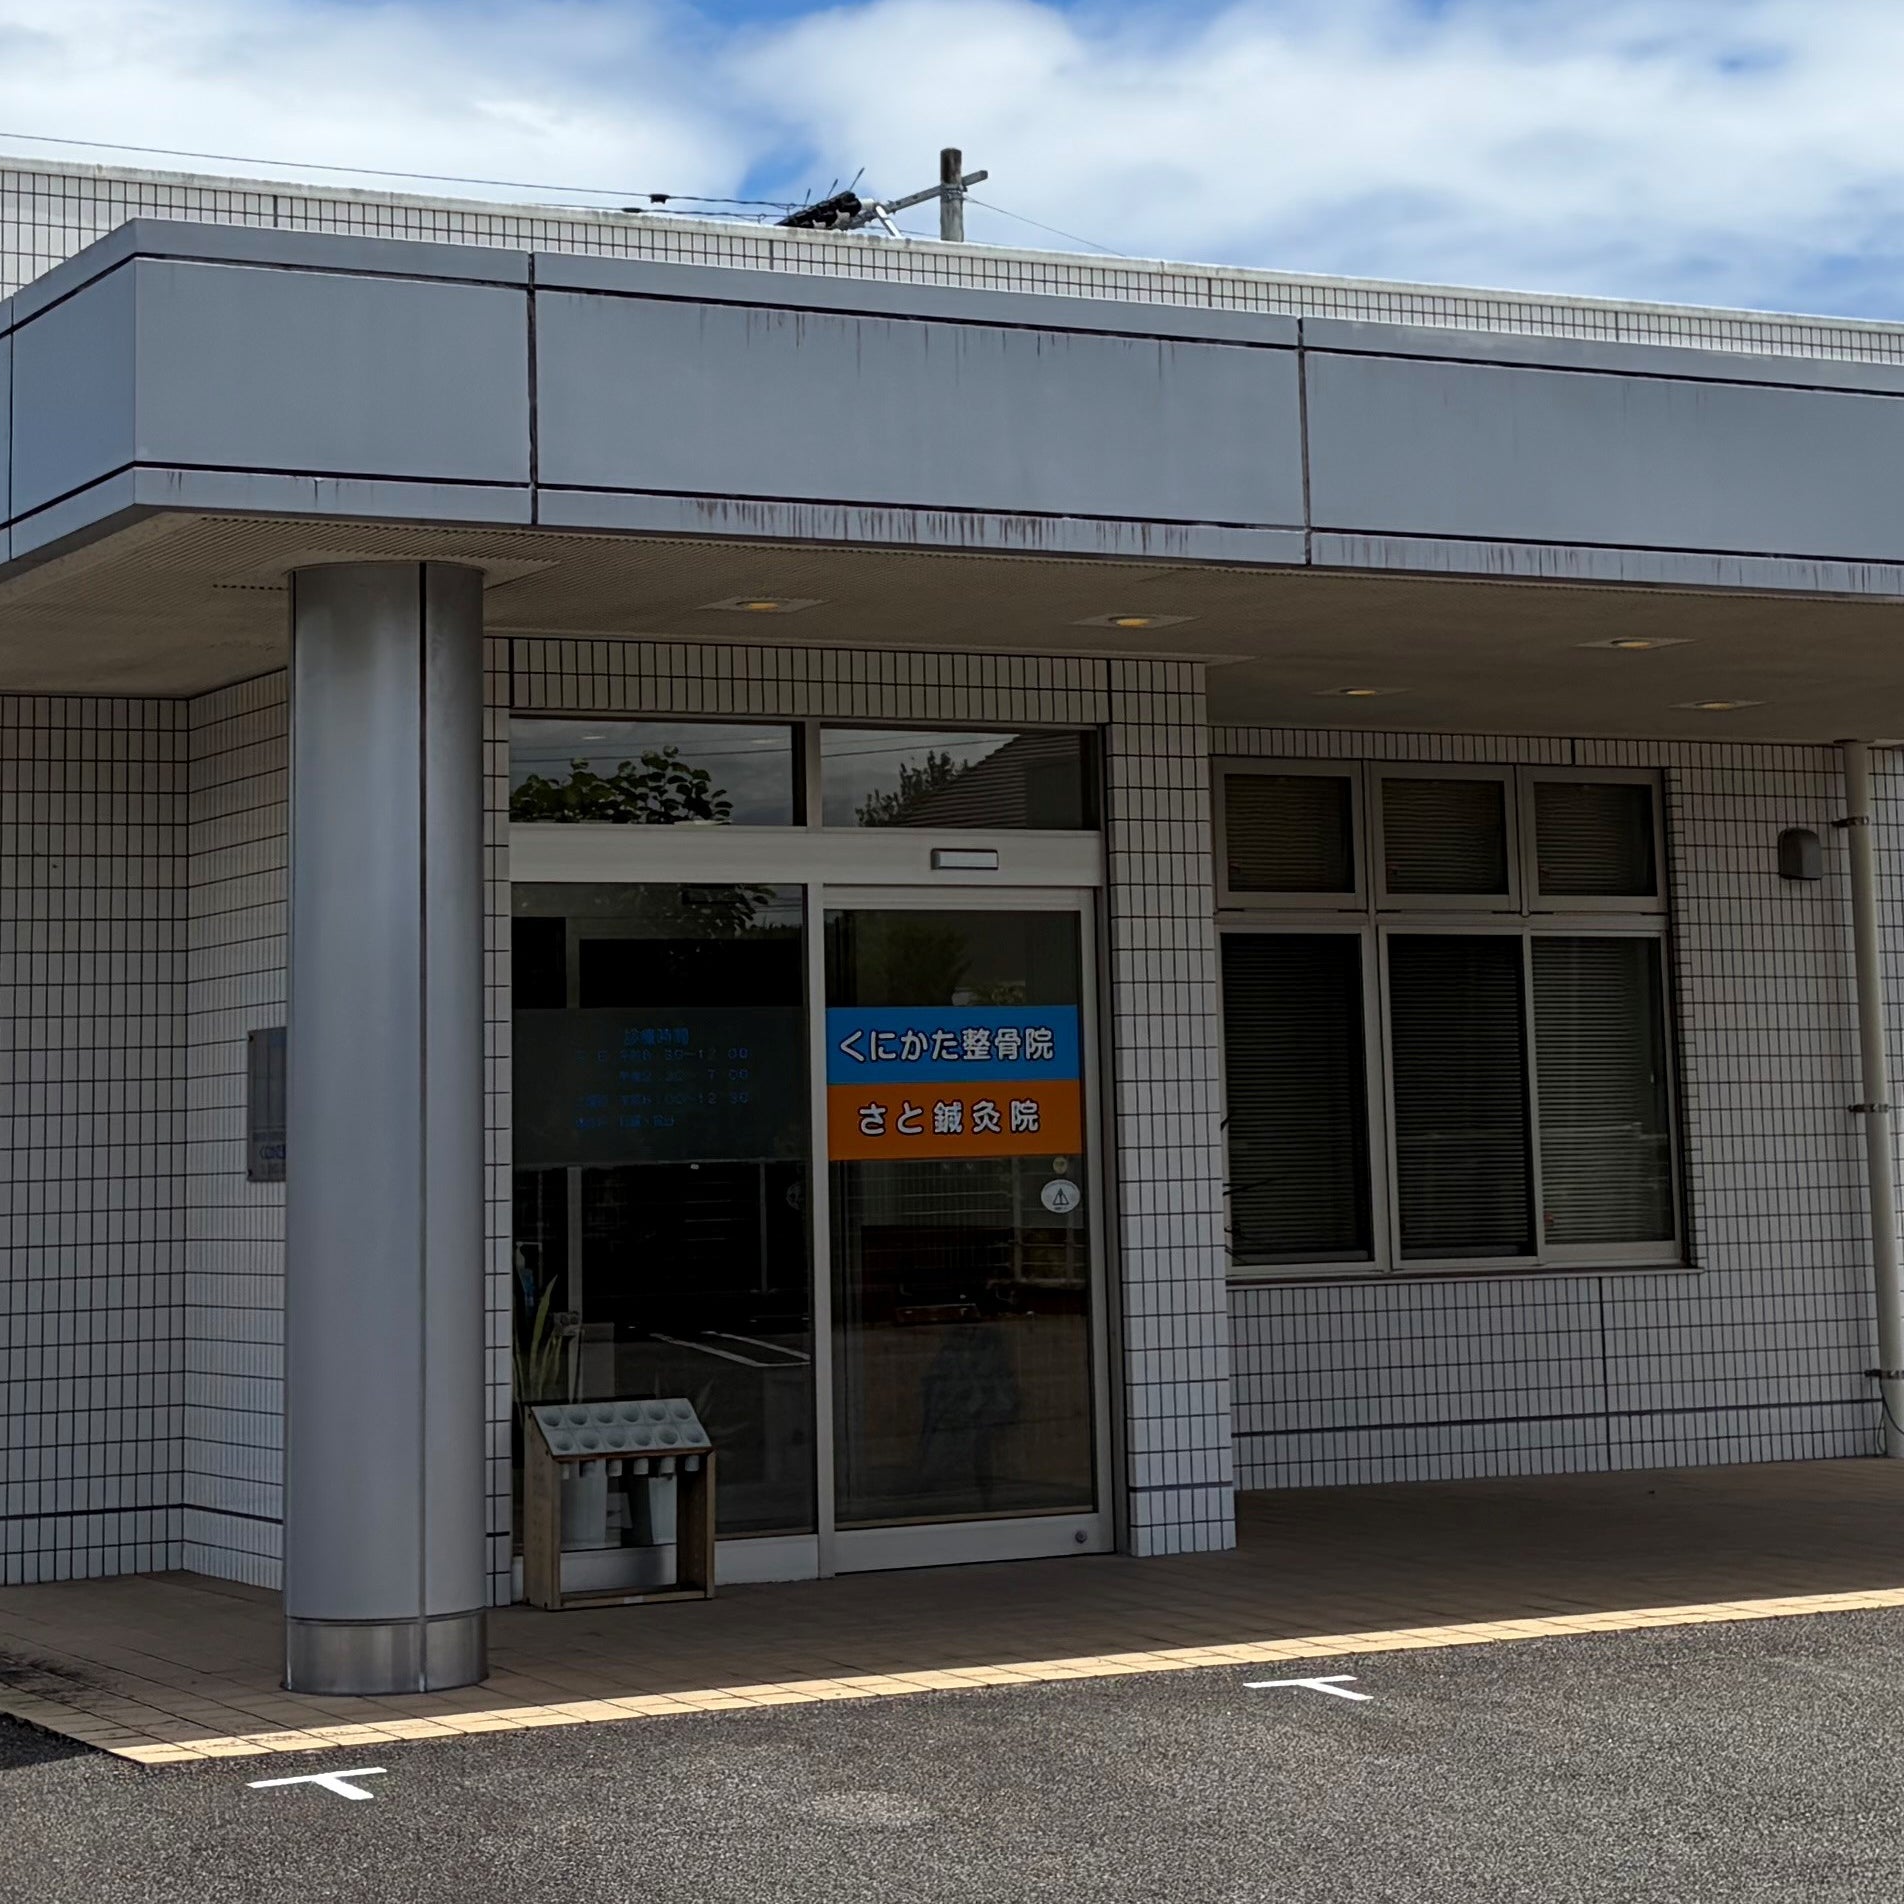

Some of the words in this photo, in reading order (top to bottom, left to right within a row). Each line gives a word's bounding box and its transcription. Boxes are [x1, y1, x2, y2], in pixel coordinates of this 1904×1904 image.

[839, 1026, 1055, 1063] くにかた整骨院
[858, 1098, 1041, 1136] さと鍼灸院
